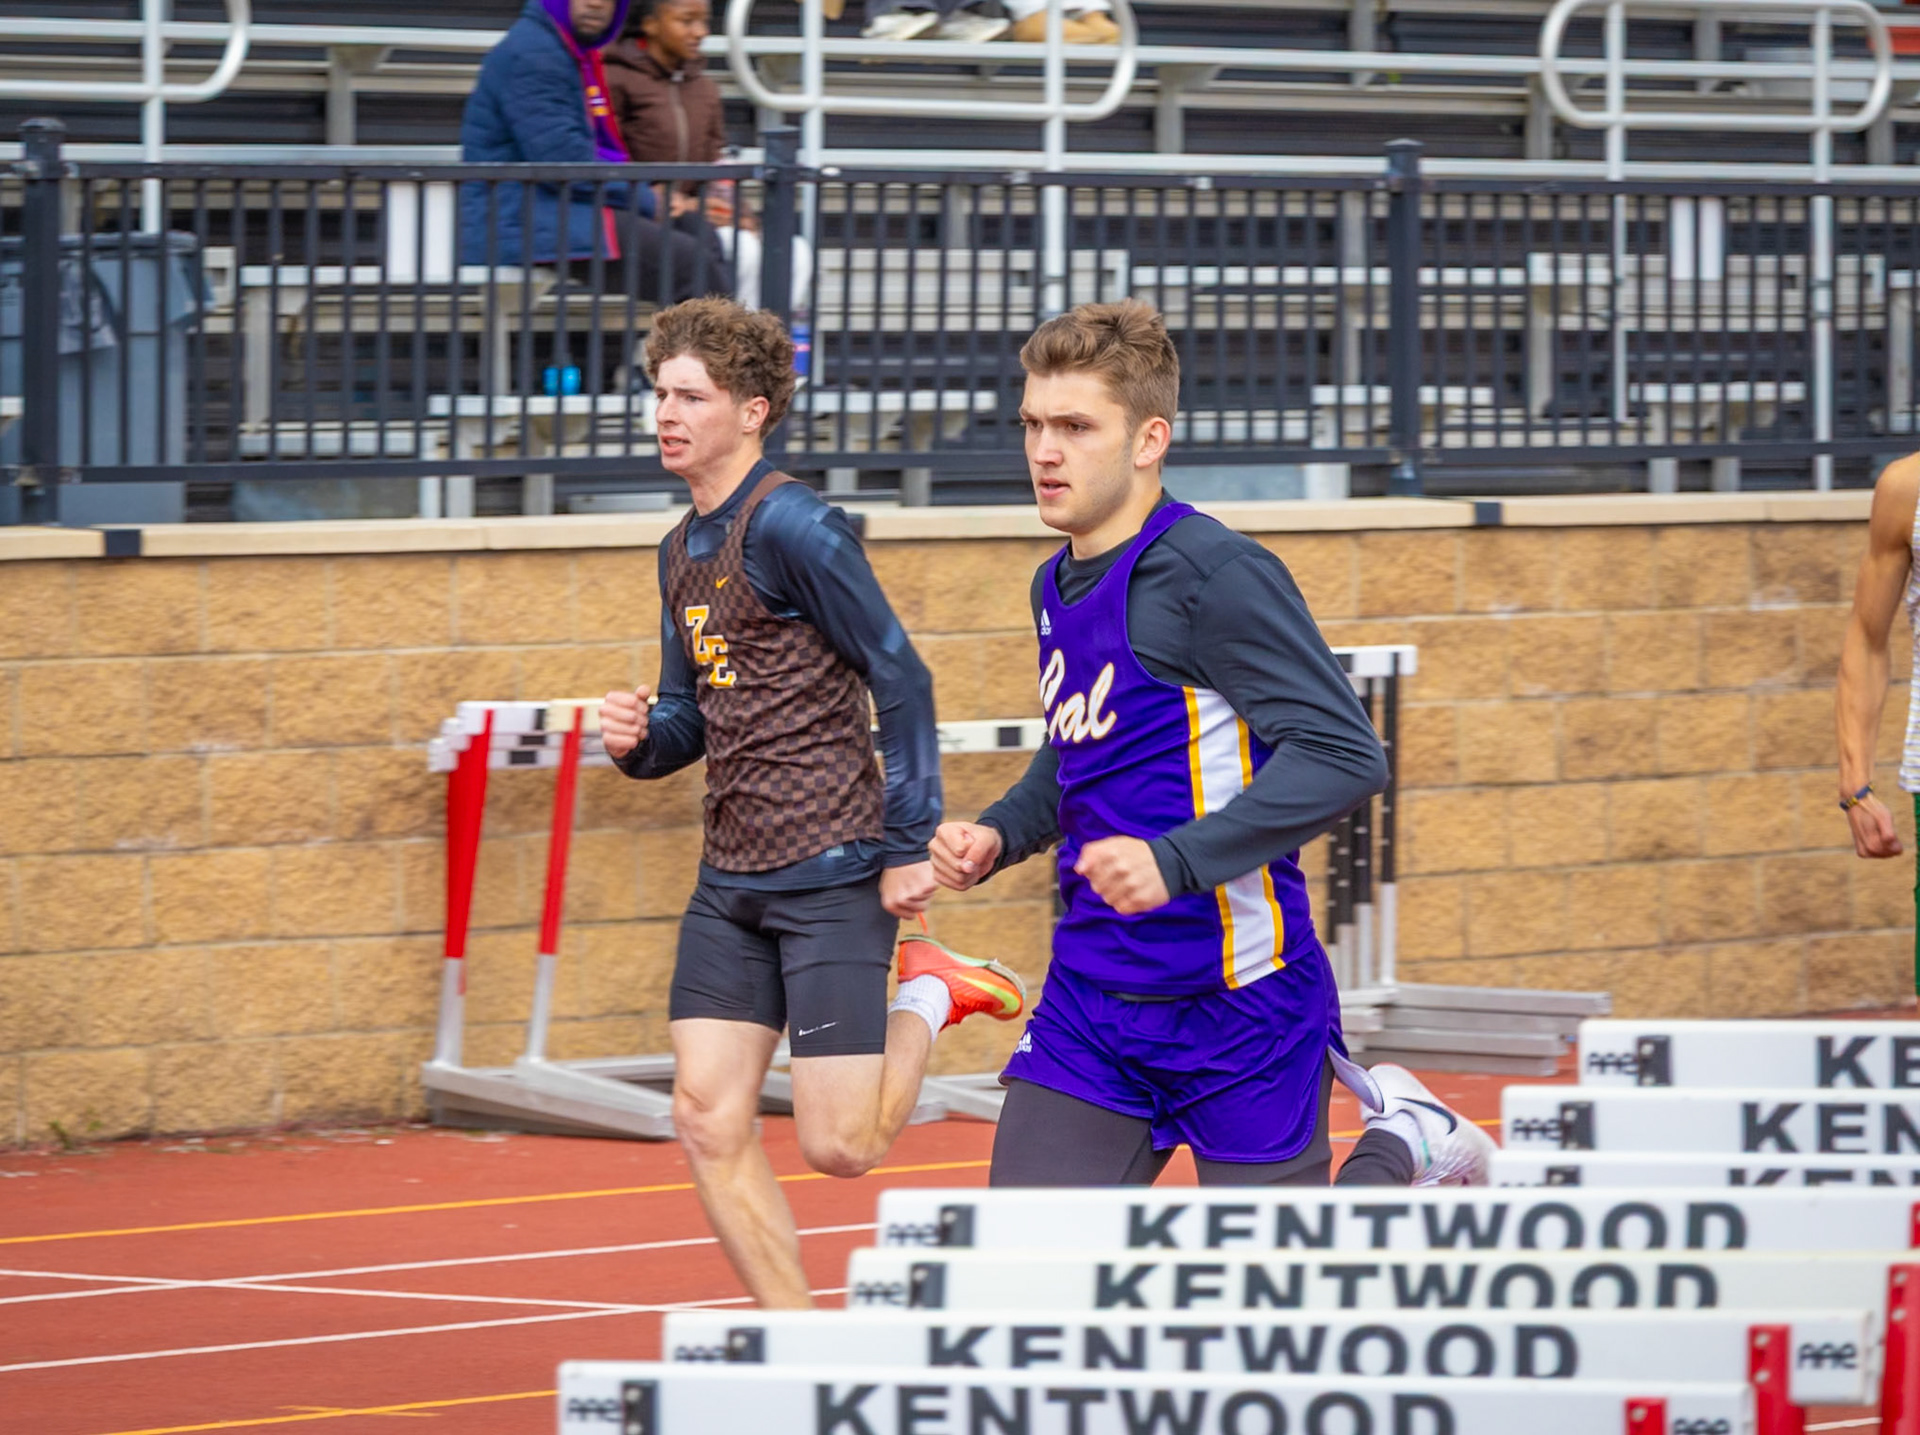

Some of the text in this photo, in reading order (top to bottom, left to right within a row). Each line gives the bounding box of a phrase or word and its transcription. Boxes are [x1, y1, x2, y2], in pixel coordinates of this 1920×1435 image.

[1126, 1202, 1748, 1250] KENTWOOD
[1094, 1261, 1720, 1310] KENTWOOD
[927, 1324, 1580, 1378] KENTWOOD
[814, 1383, 1457, 1435] KENTWOOD
